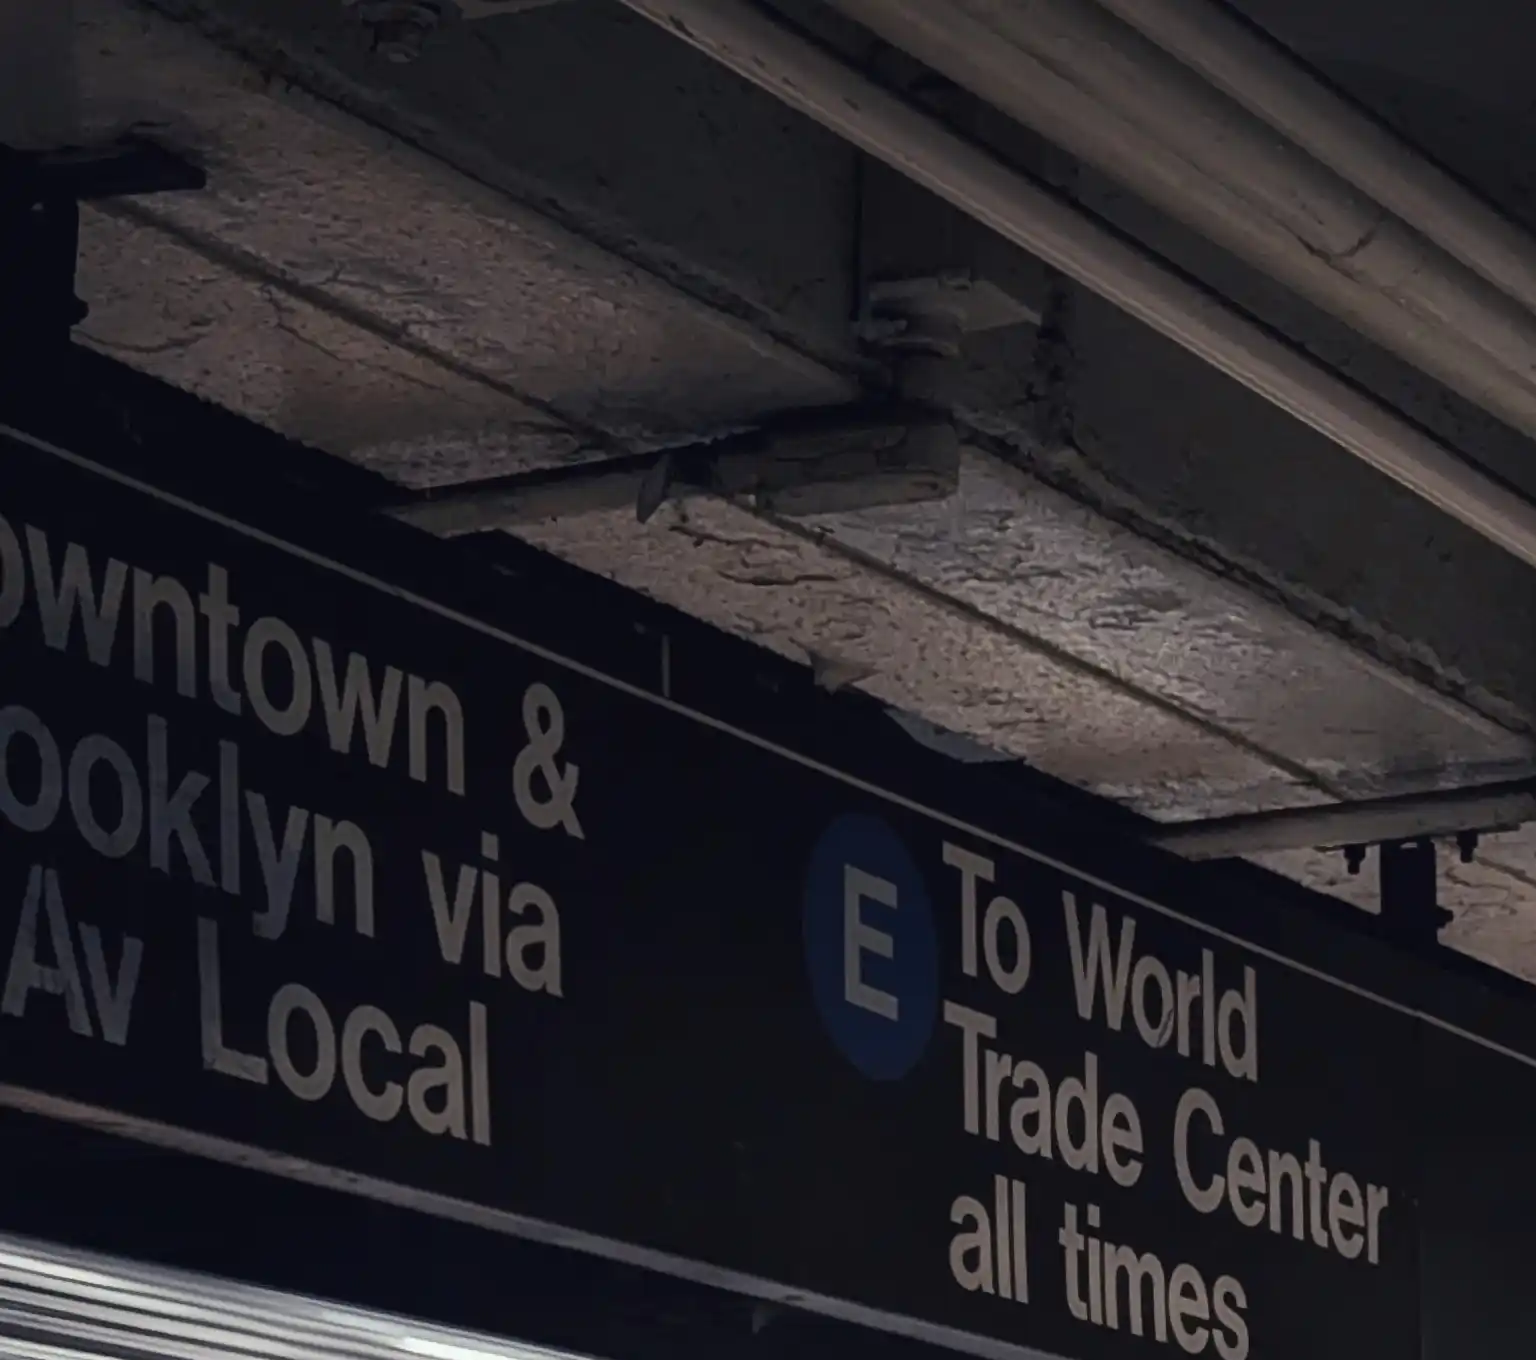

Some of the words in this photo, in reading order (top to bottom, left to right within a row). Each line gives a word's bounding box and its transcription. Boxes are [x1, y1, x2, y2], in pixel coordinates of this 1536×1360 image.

[512, 682, 585, 840] &
[421, 830, 565, 999] via
[842, 862, 899, 1023] E
[941, 839, 1032, 995] To
[1061, 889, 1259, 1083] World
[197, 914, 492, 1147] Local
[943, 999, 1144, 1188] Trade
[1173, 1087, 1390, 1266] Center
[948, 1173, 1030, 1304] all
